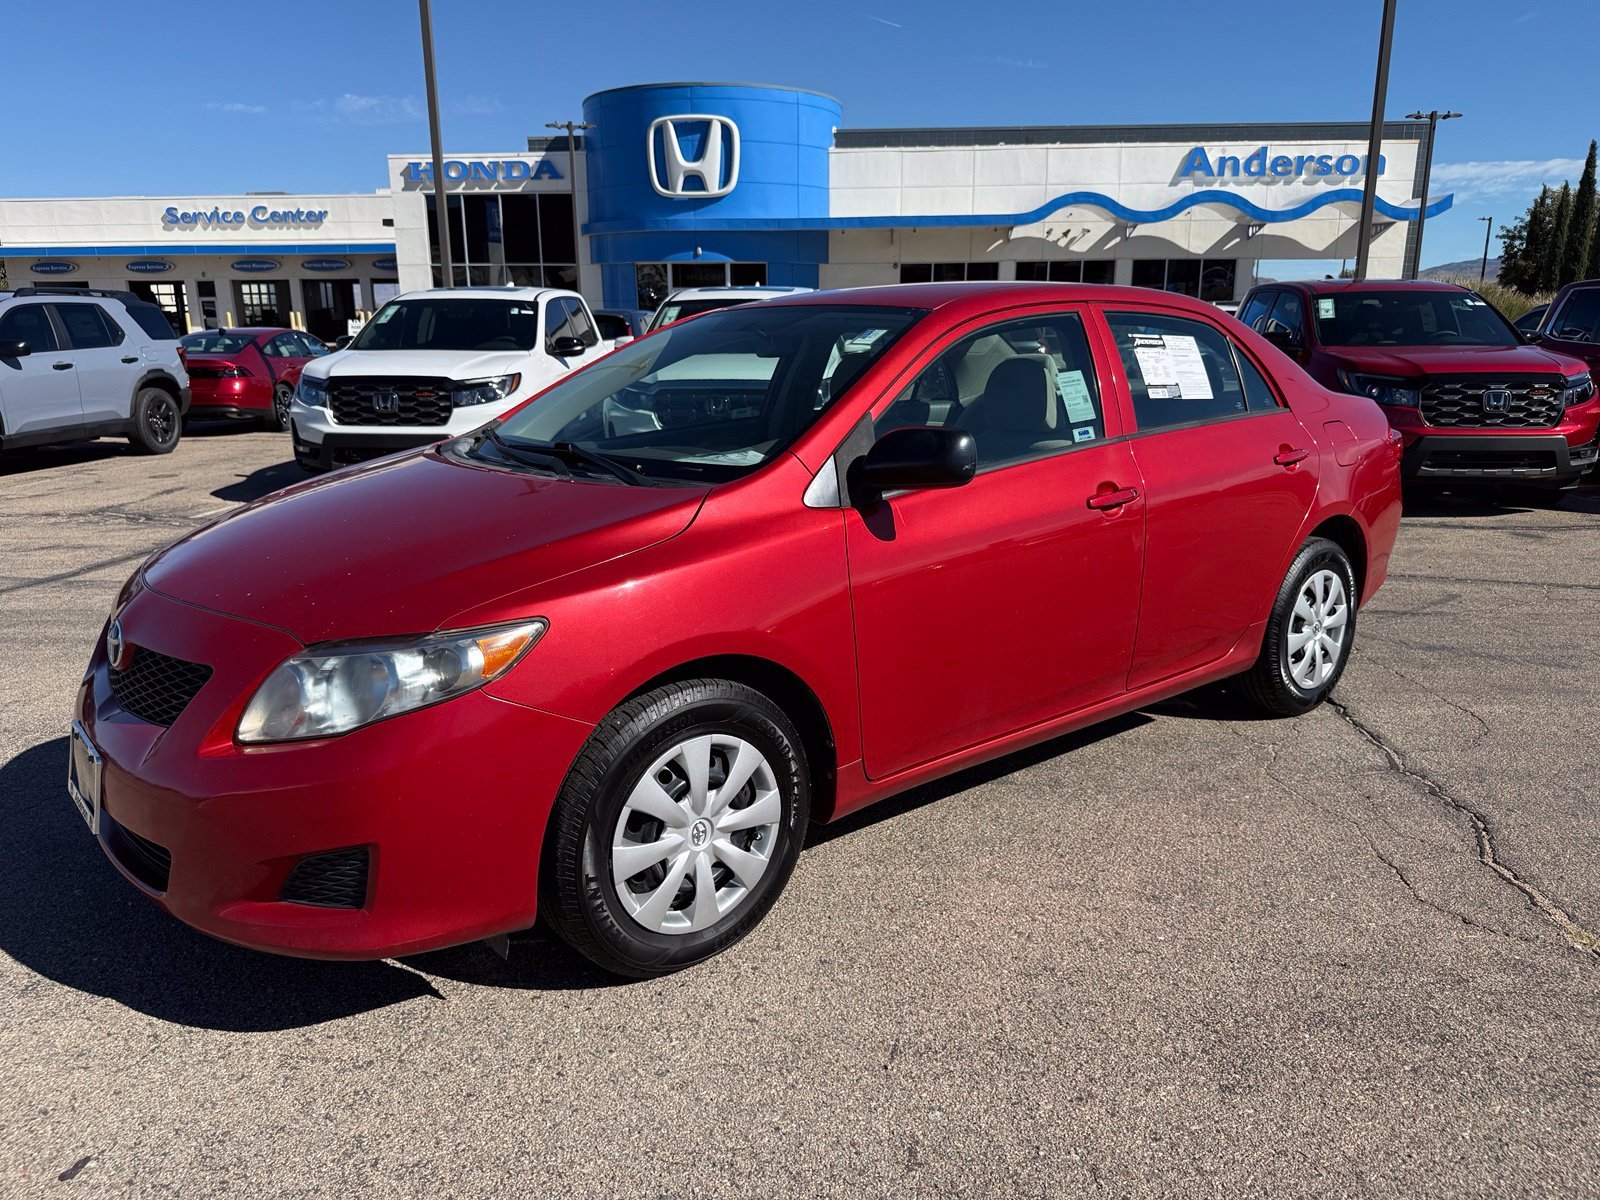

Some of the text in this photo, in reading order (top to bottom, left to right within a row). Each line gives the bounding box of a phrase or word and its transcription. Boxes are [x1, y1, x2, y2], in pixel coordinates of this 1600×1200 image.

[408, 160, 564, 181] HONDA
[165, 205, 329, 224] Service Center
